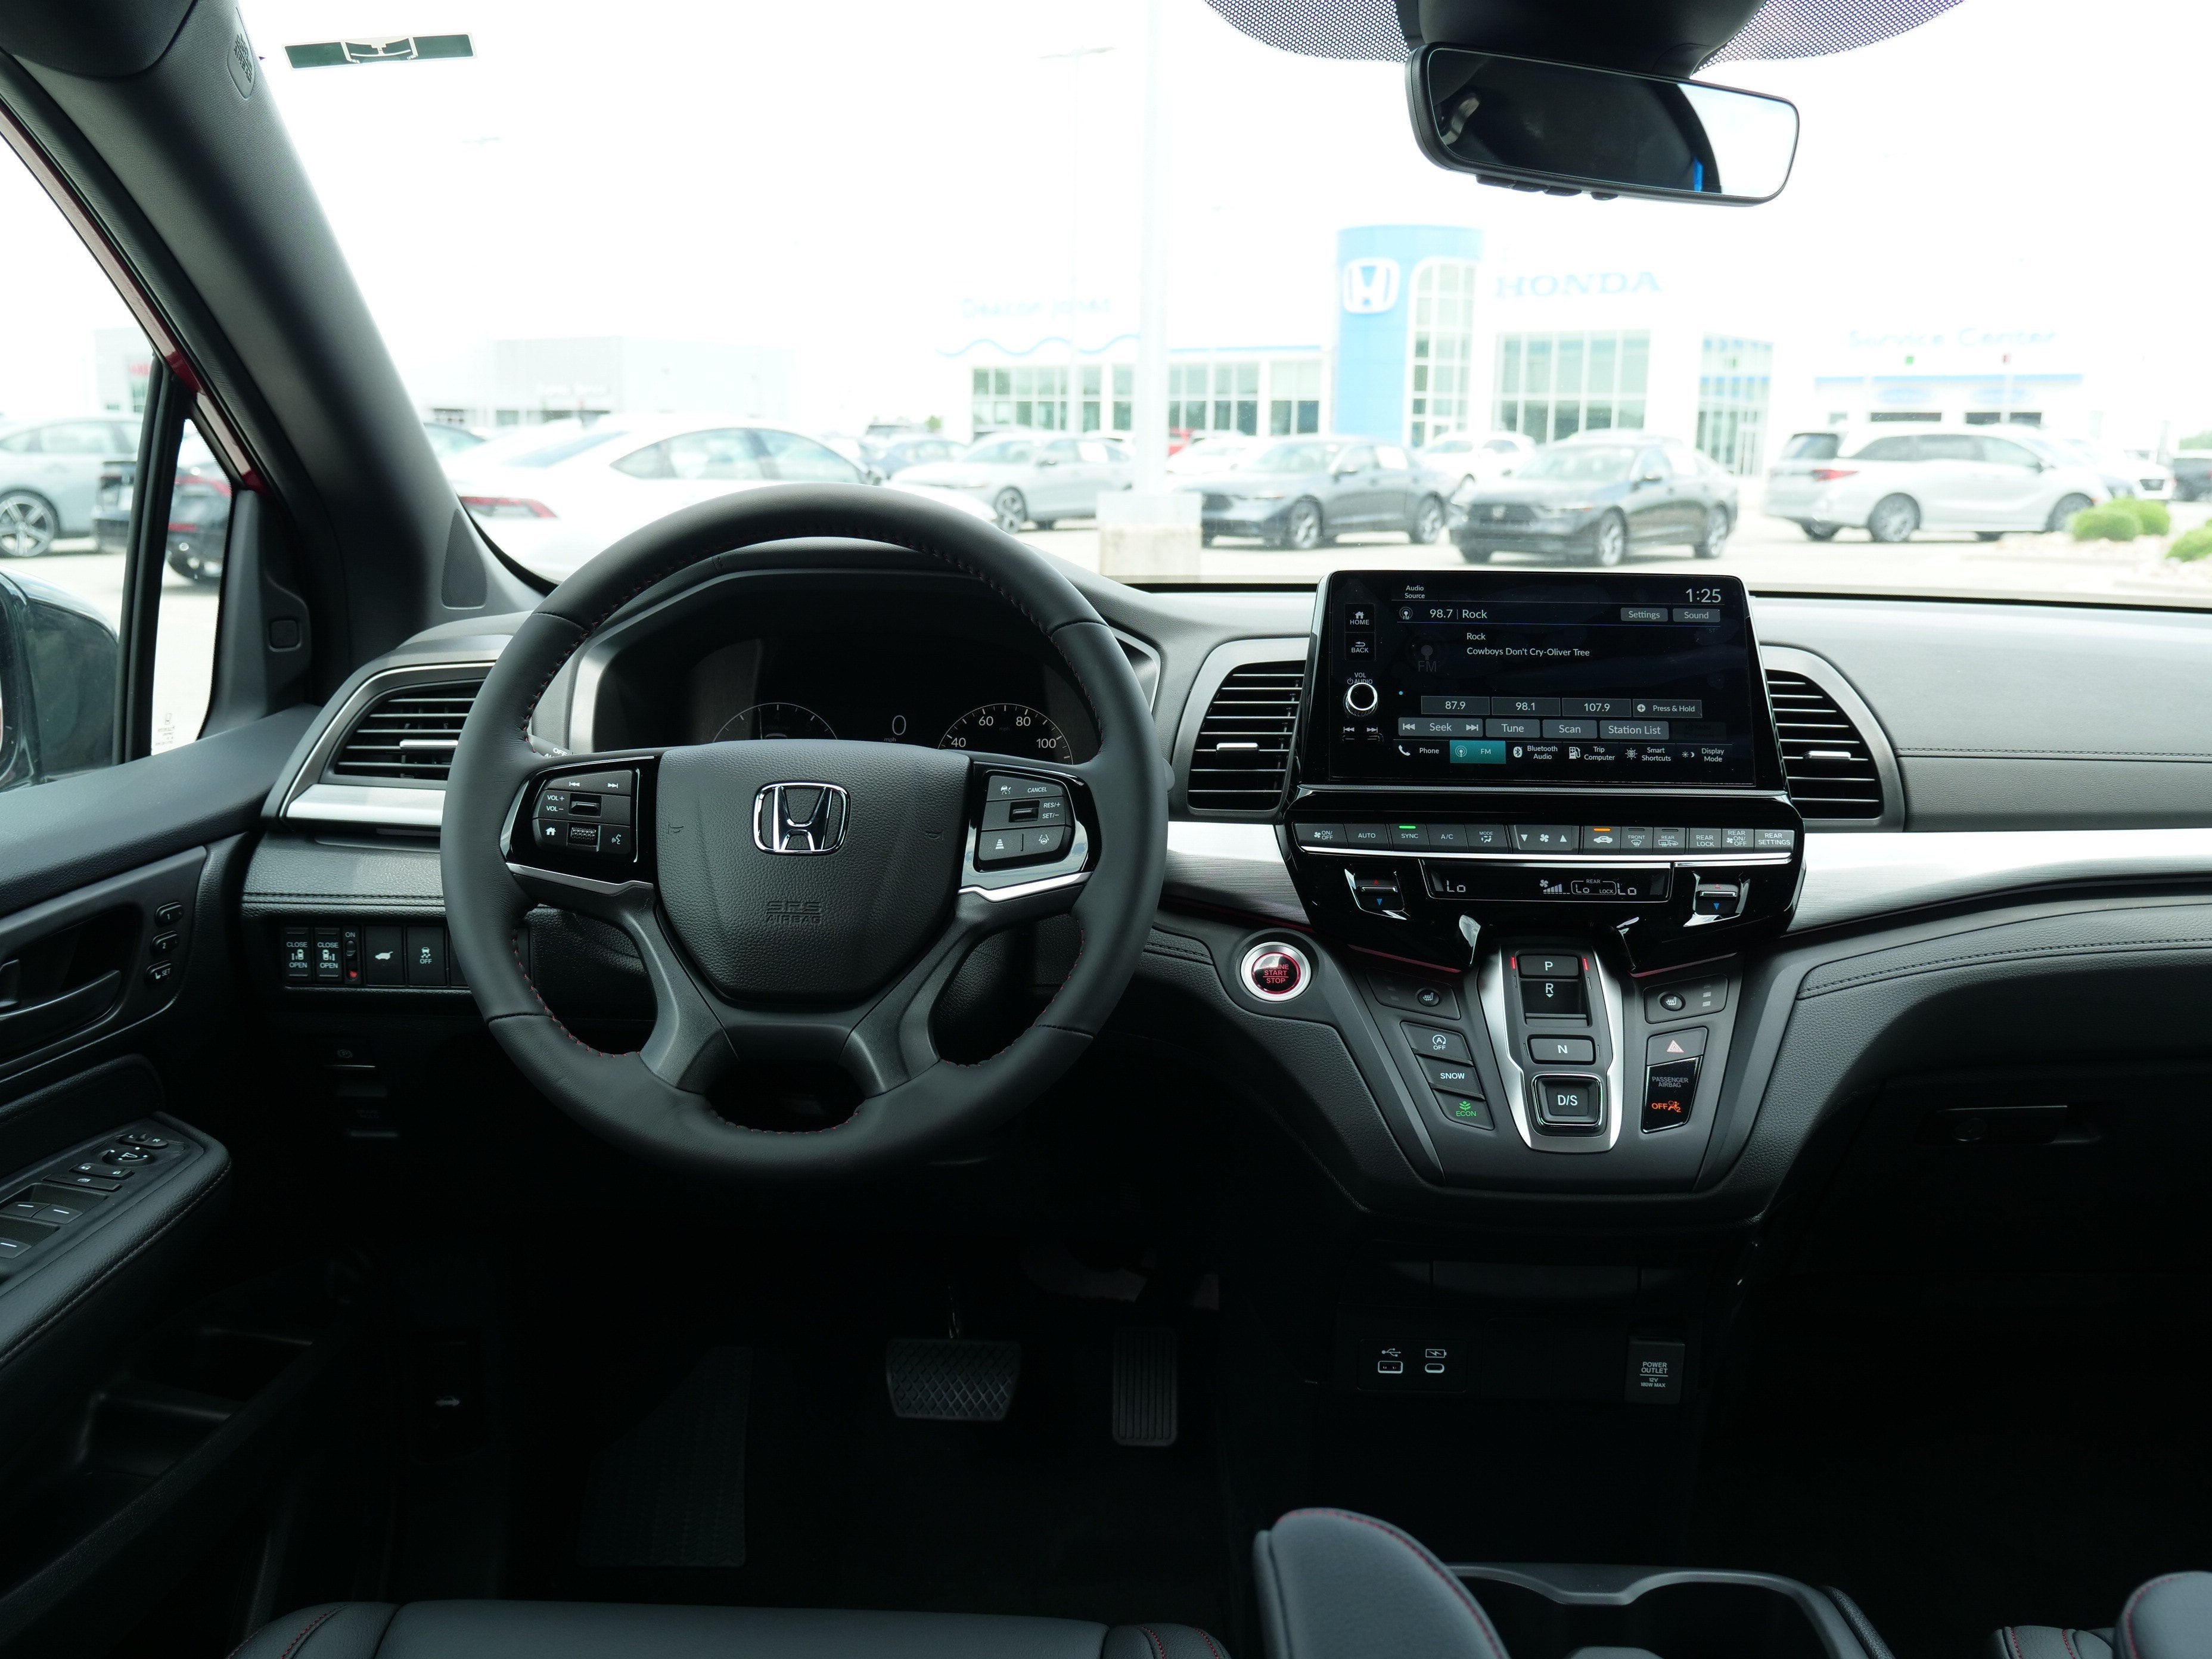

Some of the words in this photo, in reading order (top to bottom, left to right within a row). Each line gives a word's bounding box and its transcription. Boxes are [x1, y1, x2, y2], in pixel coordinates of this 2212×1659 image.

[1494, 271, 1663, 299] HONDA
[1685, 588, 1722, 602] 1:25
[1430, 609, 1453, 618] 98.7
[1462, 610, 1487, 619] Rock
[1628, 611, 1660, 619] Settings
[1467, 647, 1503, 656] Cowboys
[1530, 648, 1571, 657] Cry-Oliver
[1445, 701, 1466, 710] 87.9
[1515, 702, 1536, 710] 98.1
[1583, 703, 1610, 712] 107.9
[892, 715, 906, 736] 0
[978, 716, 994, 726] 60
[1015, 716, 1031, 726] 80
[1430, 723, 1452, 732] Seek
[1501, 723, 1524, 732] Tune
[1559, 725, 1581, 734] Scan
[1608, 725, 1641, 734] Station
[1645, 726, 1661, 734] List
[950, 737, 967, 748] 40
[1036, 738, 1057, 748] 100
[552, 747, 568, 756] OFF
[1446, 880, 1466, 893] Lo
[1575, 884, 1590, 893] Lo
[1617, 883, 1637, 896] Lo
[767, 901, 822, 912] SRS
[766, 915, 822, 924] AIRBAG
[1545, 961, 1553, 971] P
[161, 968, 171, 977] SET
[1545, 983, 1554, 994] R
[1557, 1045, 1568, 1054] N
[1557, 1095, 1578, 1106] D/S
